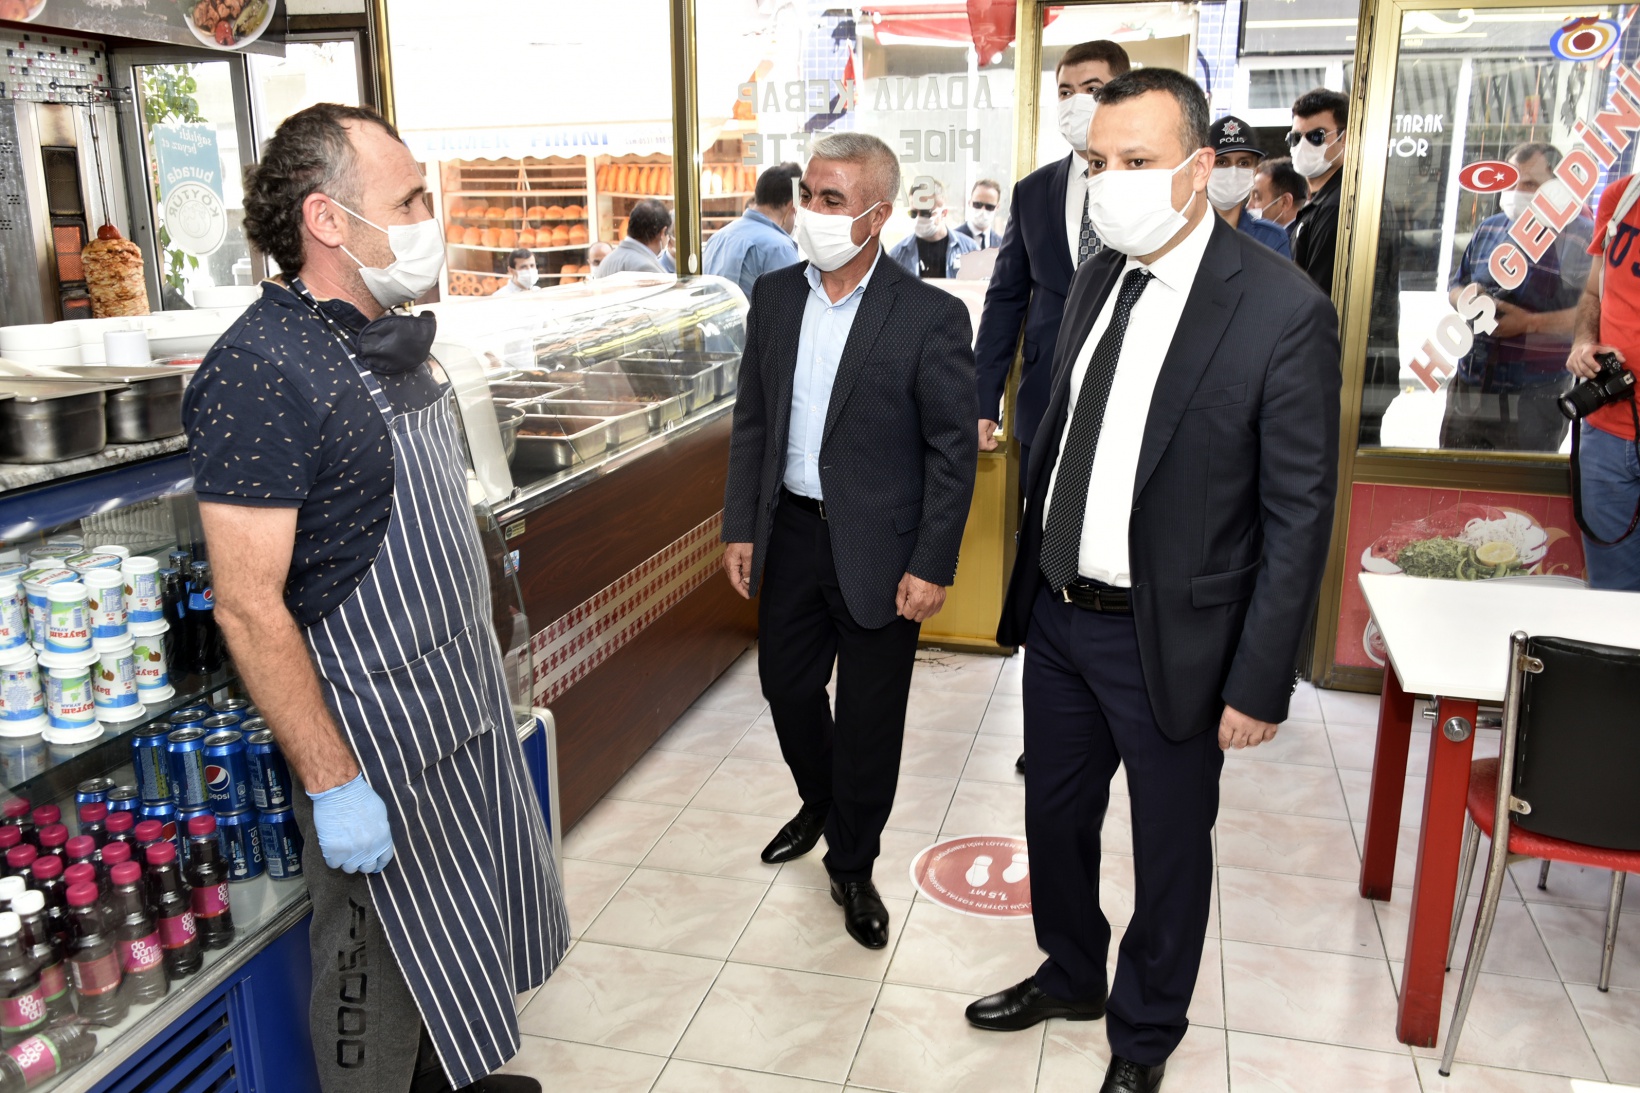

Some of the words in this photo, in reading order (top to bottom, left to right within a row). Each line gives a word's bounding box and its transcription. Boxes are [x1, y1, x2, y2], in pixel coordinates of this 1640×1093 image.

[1395, 113, 1444, 133] TARAK
[1408, 282, 1499, 394] HOŞ
[1488, 56, 1640, 291] GELDİNİ
[1608, 221, 1640, 279] U
[49, 629, 88, 639] Bayram
[135, 668, 160, 676] Bayr
[93, 685, 111, 696] Bayr
[247, 826, 263, 863] pepsi
[968, 888, 987, 897] MT
[987, 891, 1009, 902] 1,5
[946, 892, 974, 907] SOSYAL
[131, 941, 146, 951] do
